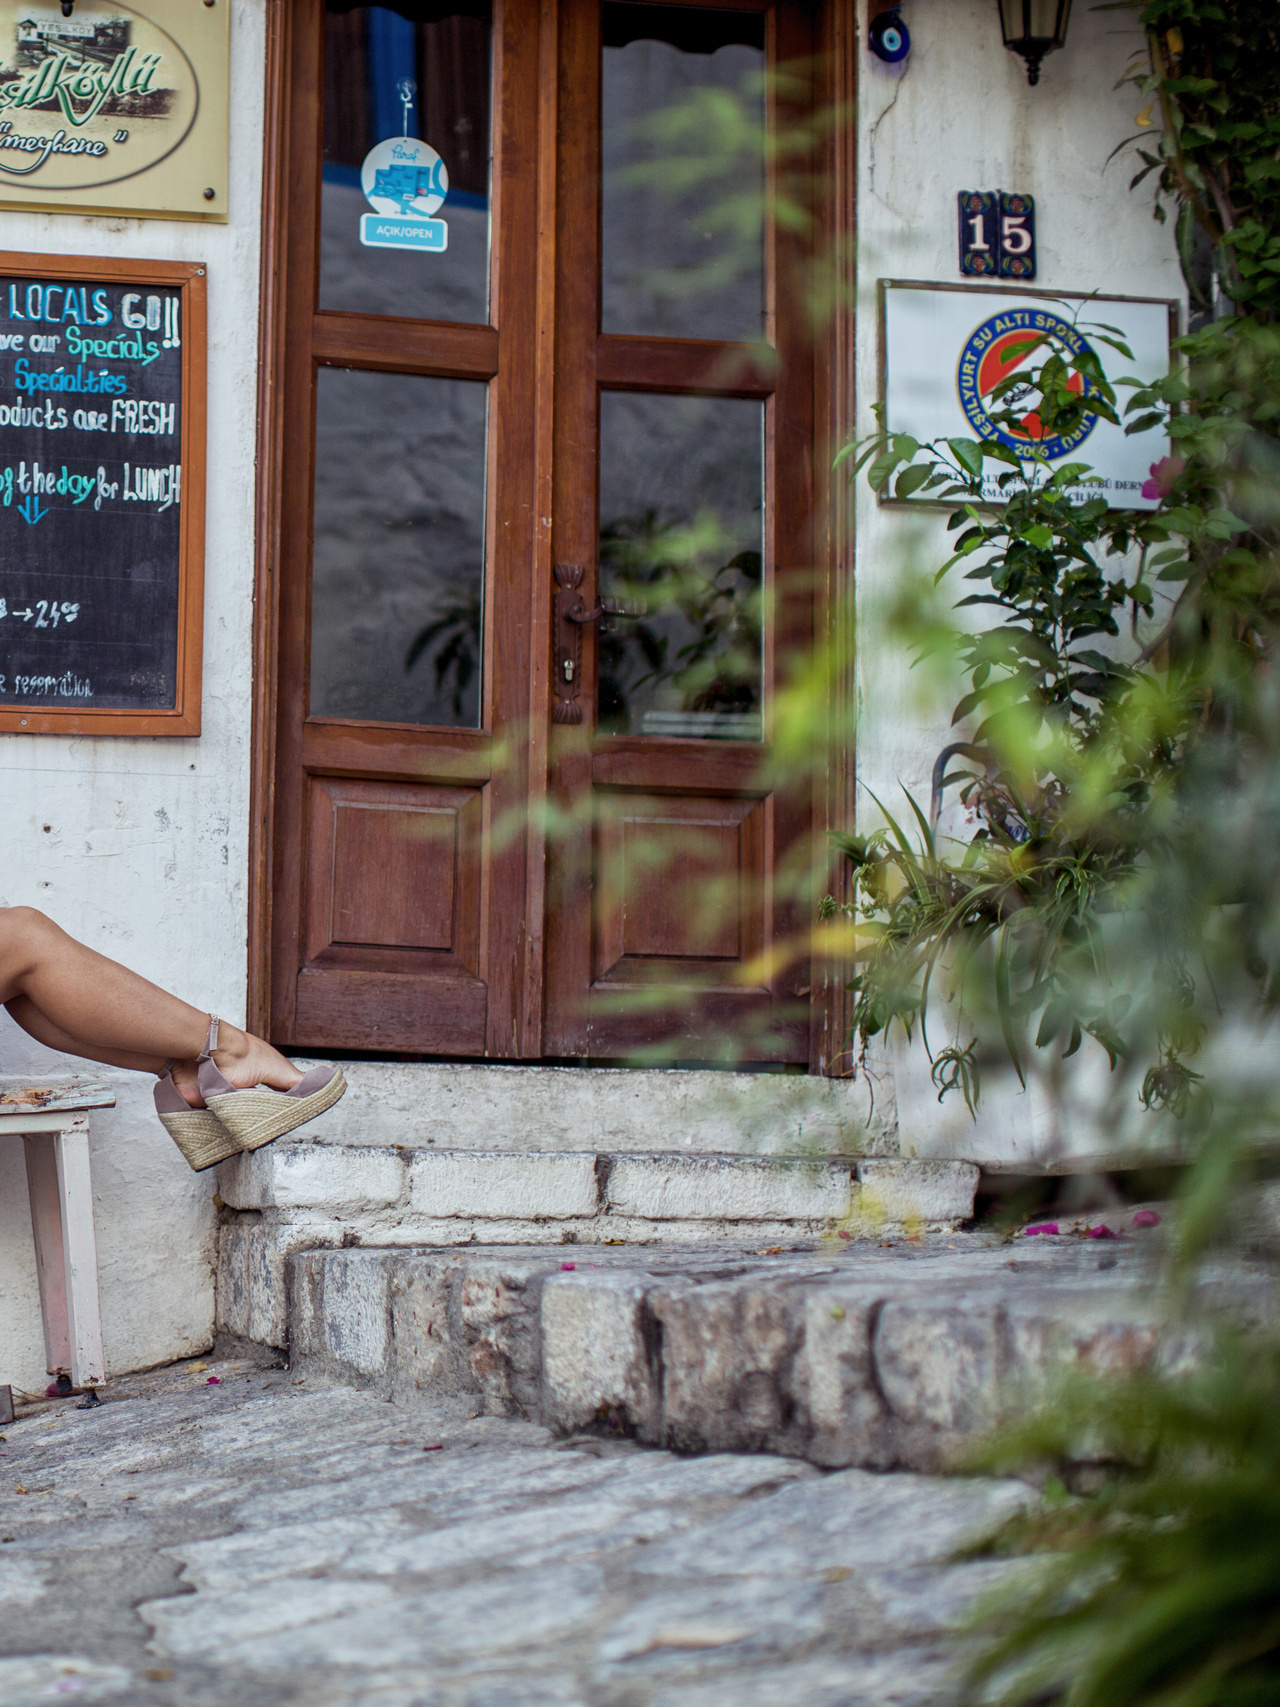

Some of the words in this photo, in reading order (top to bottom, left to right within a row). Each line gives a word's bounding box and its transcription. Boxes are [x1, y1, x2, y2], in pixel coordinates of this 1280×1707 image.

[376, 225, 433, 239] AÇIK/OPEN
[968, 214, 1032, 254] 15
[9, 284, 113, 327] LOCALS
[29, 334, 61, 353] our
[65, 325, 160, 366] Specials
[973, 327, 993, 351] SU
[994, 313, 1030, 332] ALTI
[14, 357, 128, 396] Specialties
[73, 409, 109, 432] are
[110, 398, 176, 435] FRESH
[17, 461, 57, 495] the
[56, 466, 96, 505] day
[94, 466, 119, 511] for
[123, 462, 181, 513] LUNCH
